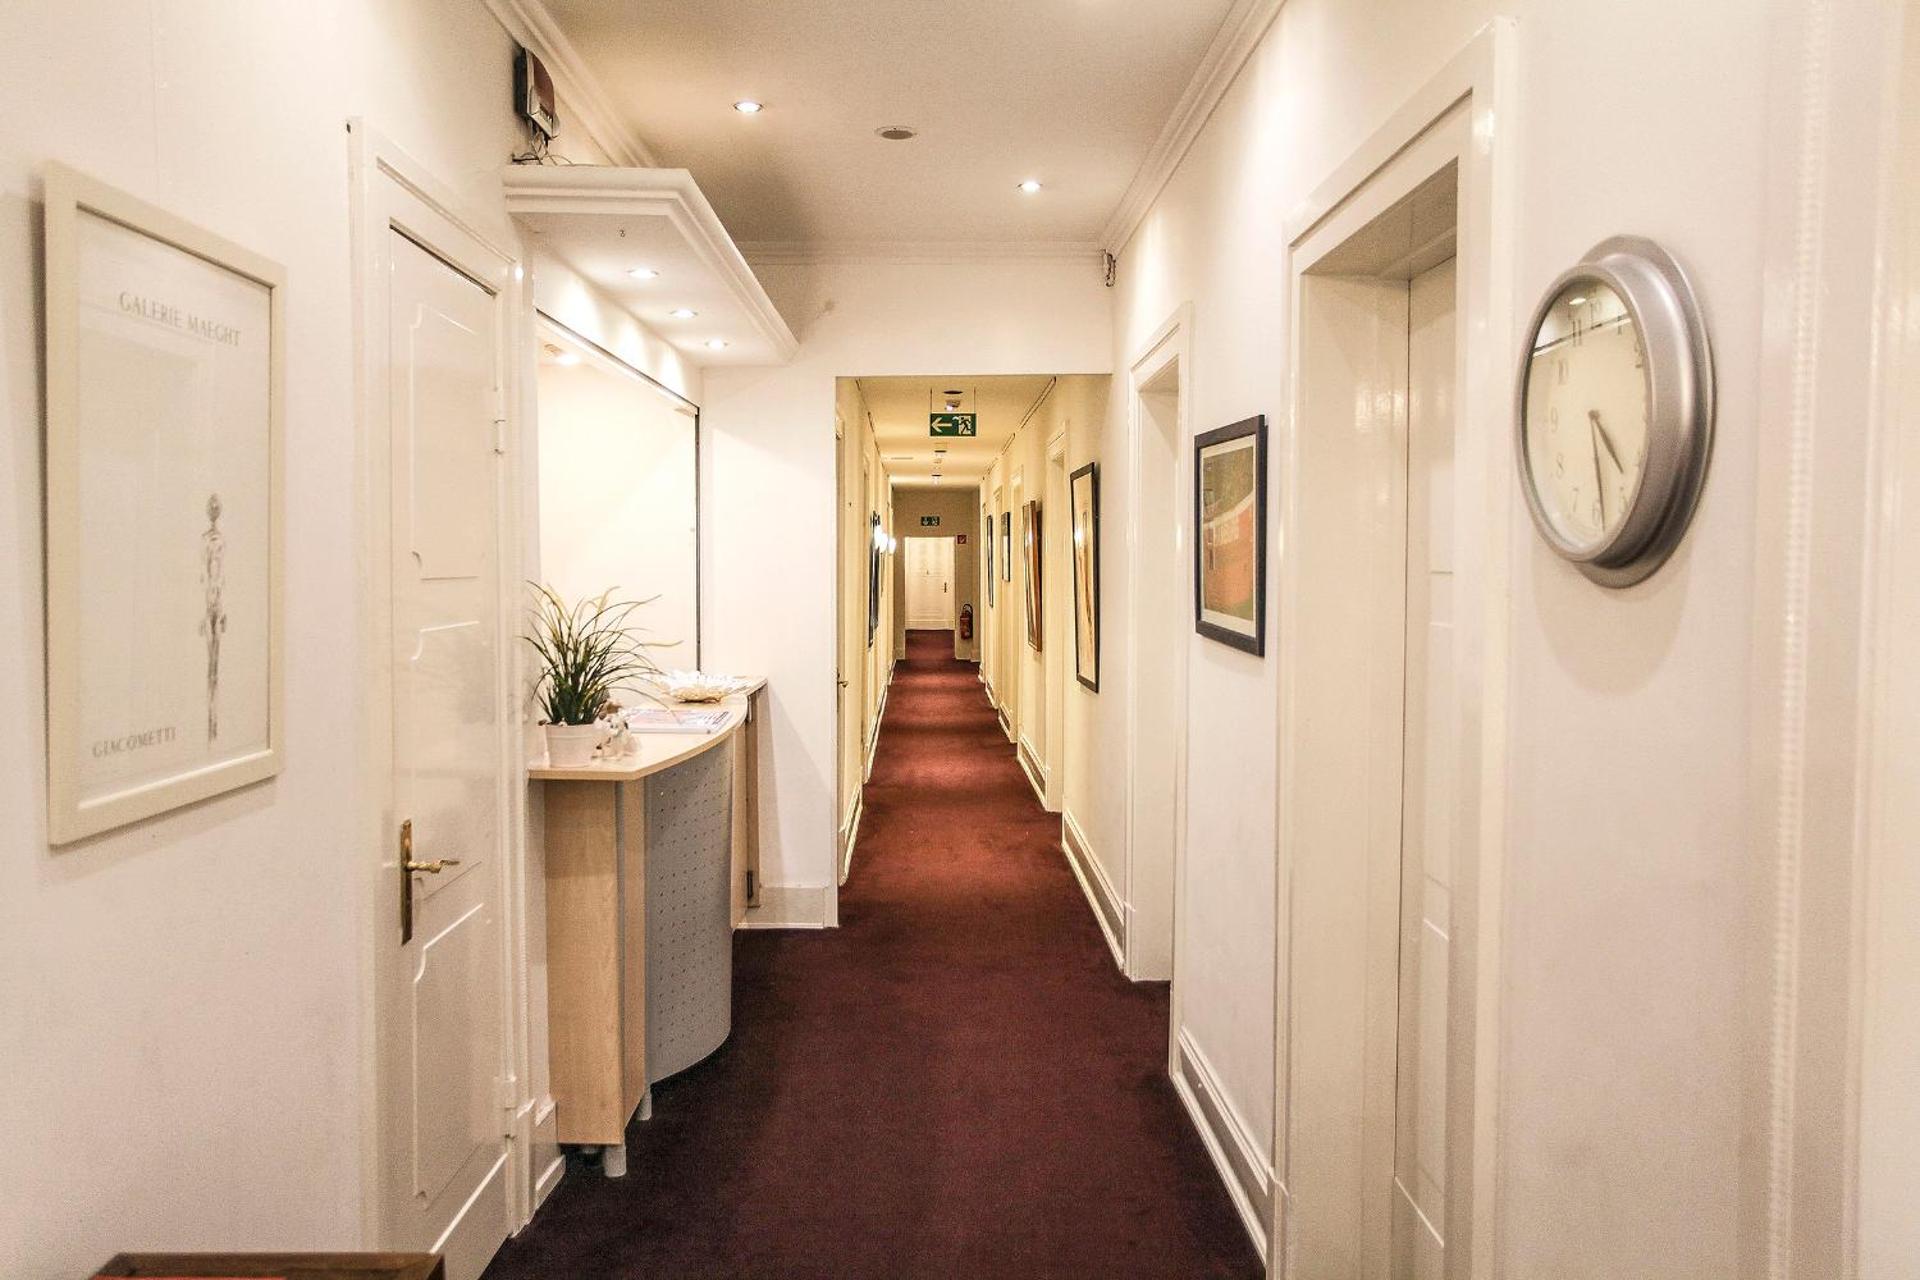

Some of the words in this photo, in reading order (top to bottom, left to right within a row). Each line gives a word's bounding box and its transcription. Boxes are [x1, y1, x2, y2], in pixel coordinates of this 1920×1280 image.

[119, 291, 182, 328] GALERIE
[187, 313, 241, 346] MAEGHT
[1571, 318, 1583, 348] 11
[1550, 406, 1559, 433] 9
[1556, 452, 1564, 479] 8
[92, 727, 177, 758] GIACOMETTI
